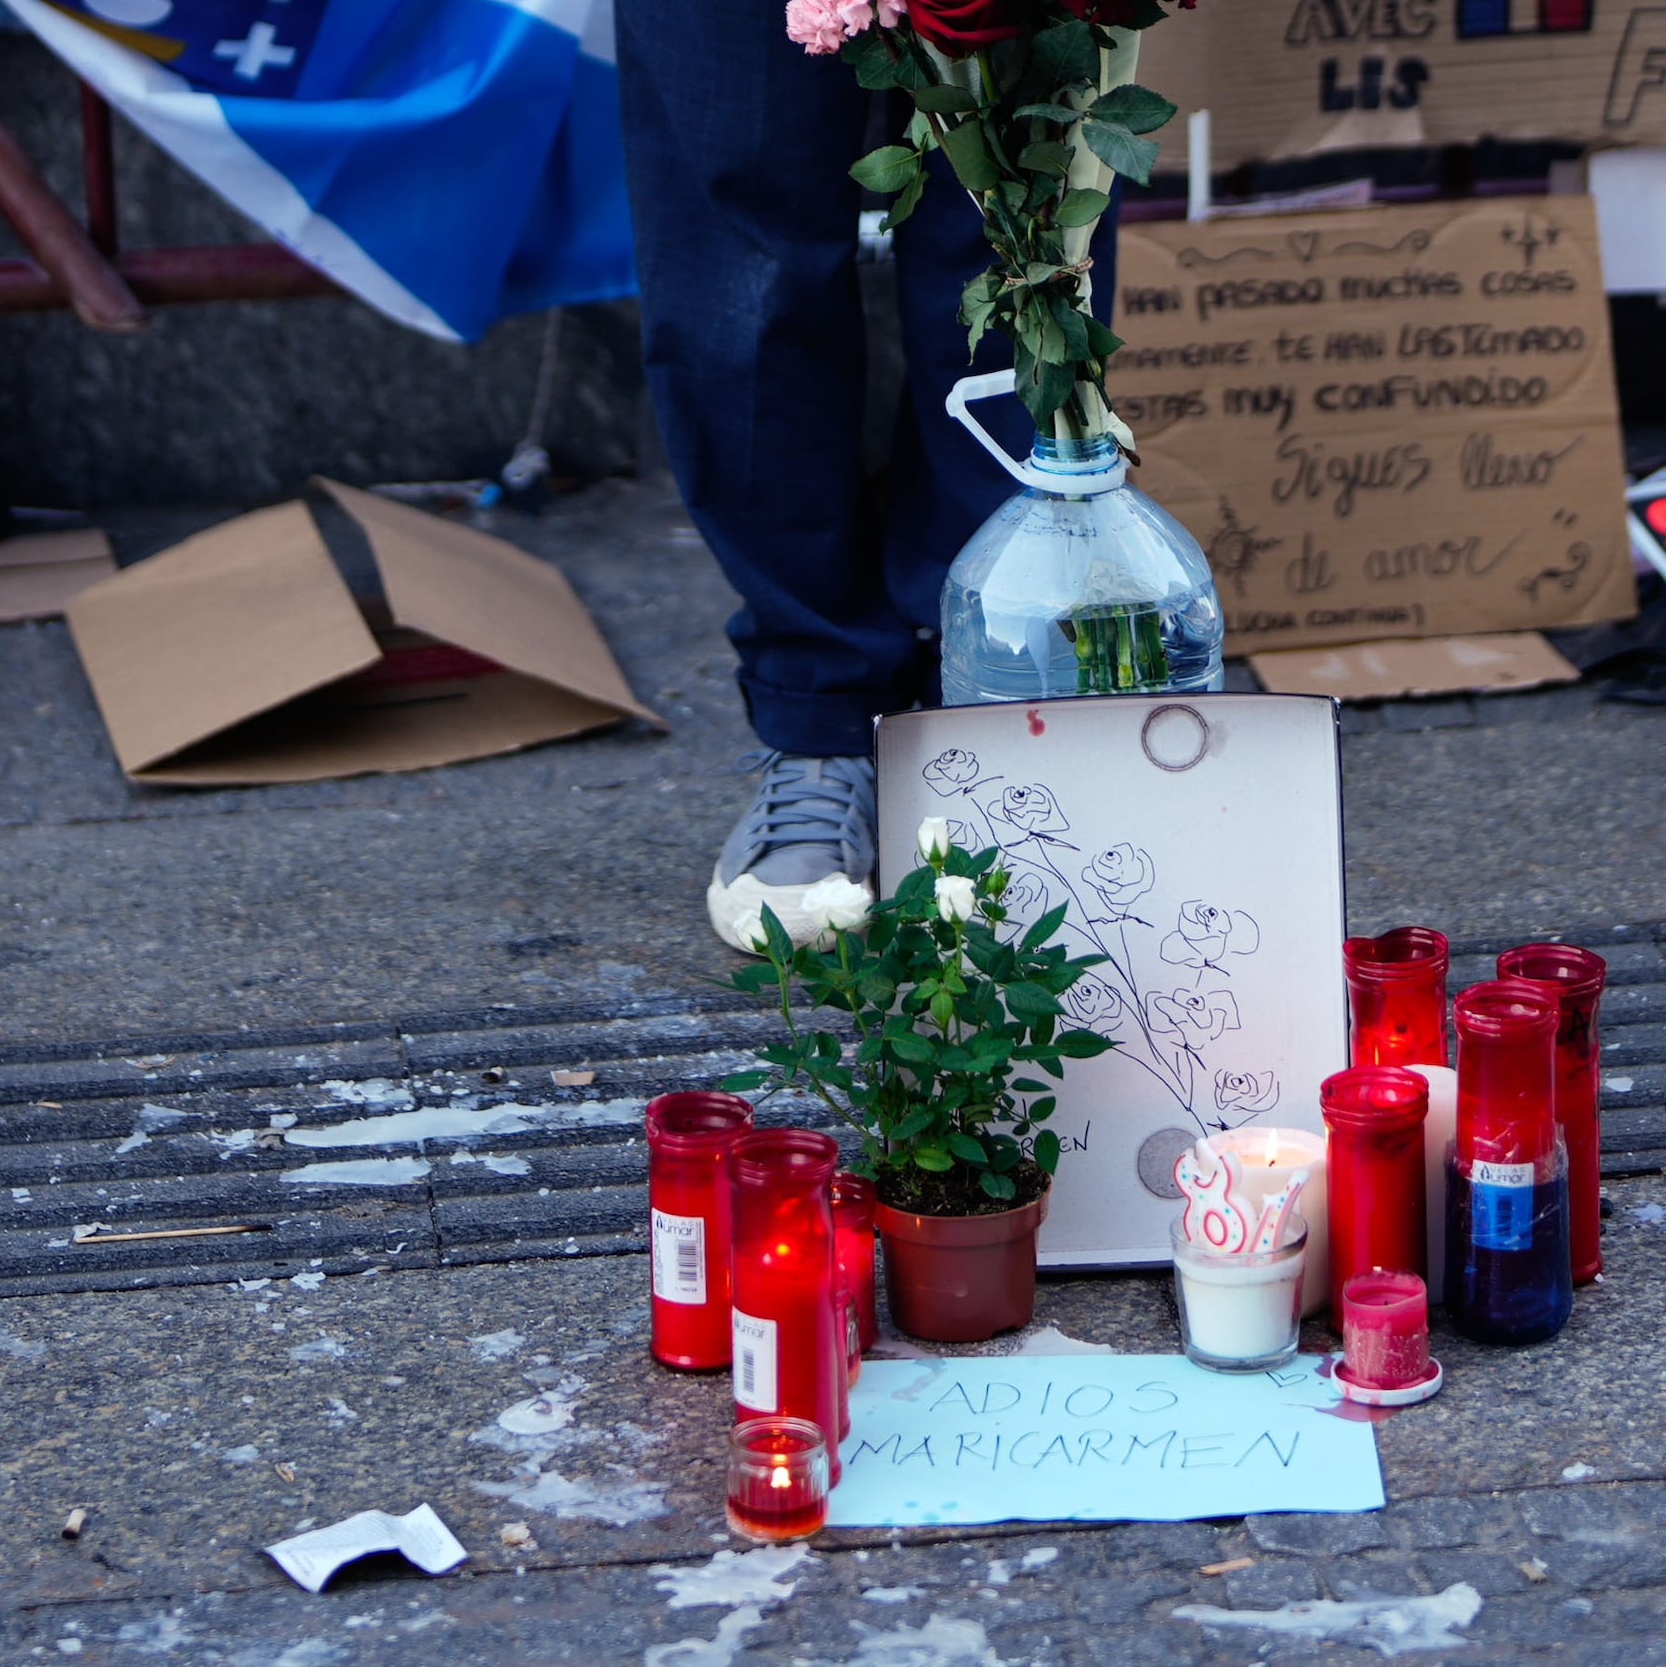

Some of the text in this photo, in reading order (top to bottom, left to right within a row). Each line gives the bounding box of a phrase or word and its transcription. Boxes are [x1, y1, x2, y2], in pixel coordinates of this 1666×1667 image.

[1320, 58, 1432, 114] LES
[1197, 278, 1325, 323] PASADO
[1481, 271, 1577, 295] COSAS
[1326, 334, 1386, 360] HAN
[1286, 521, 1527, 595] de amor
[930, 1380, 1179, 1418] ADIOS
